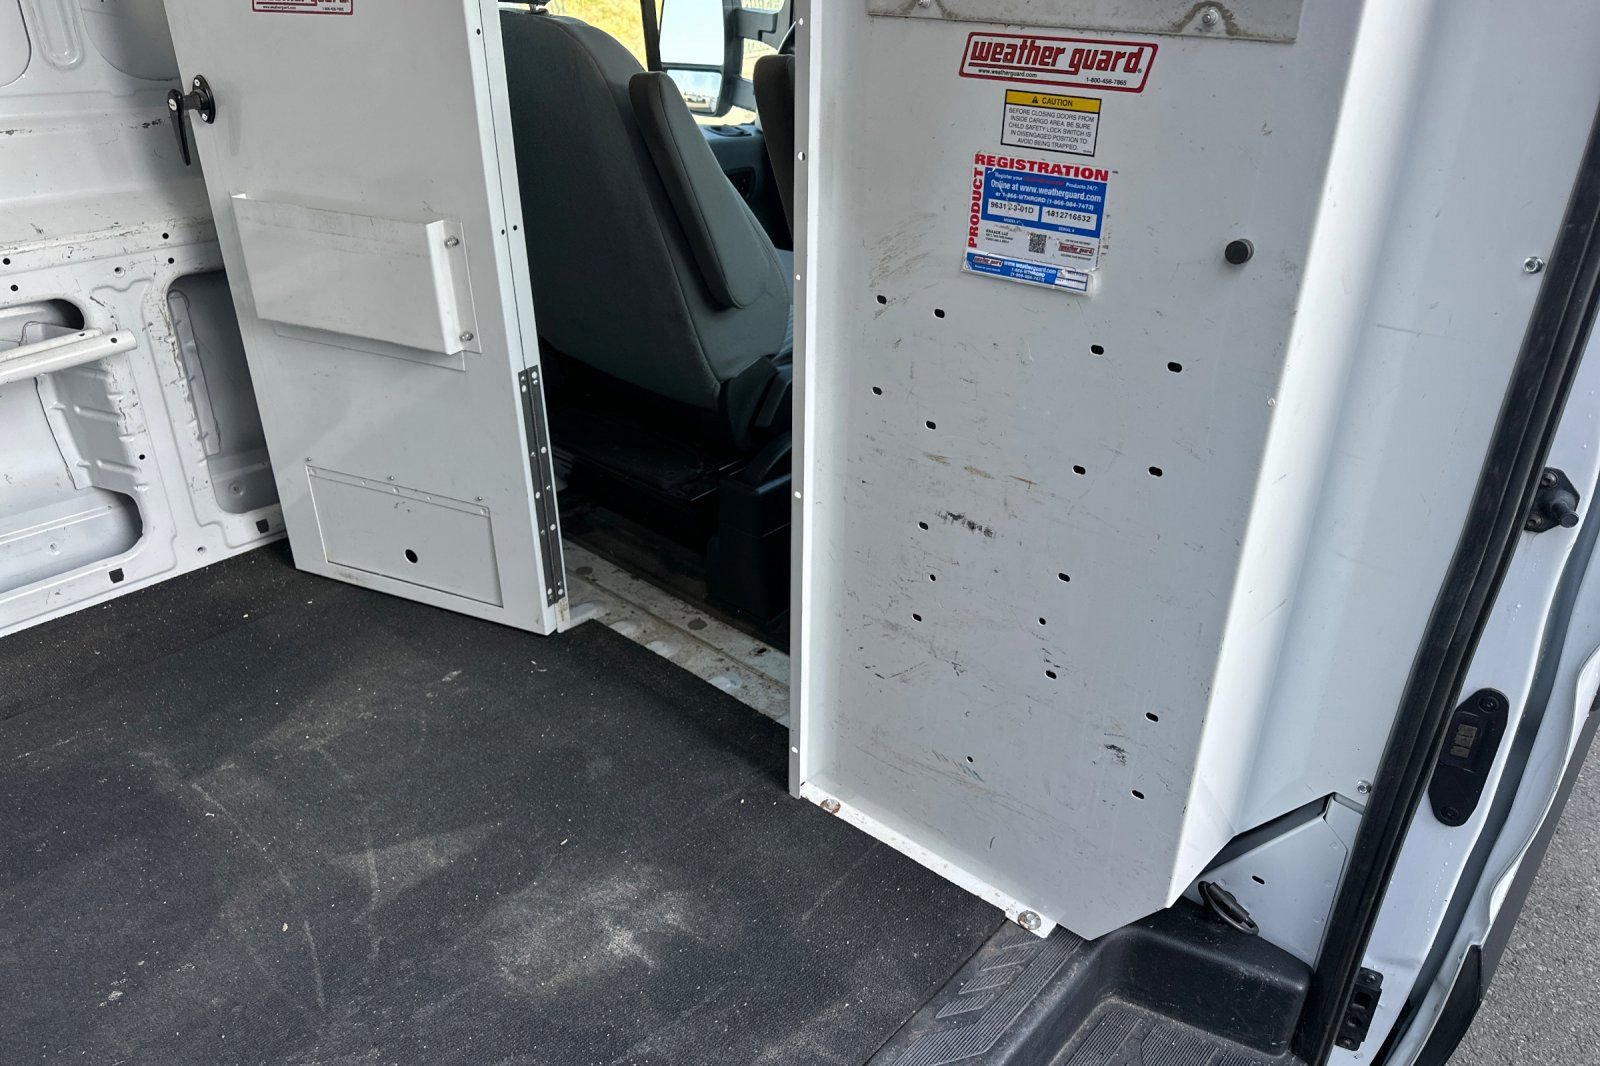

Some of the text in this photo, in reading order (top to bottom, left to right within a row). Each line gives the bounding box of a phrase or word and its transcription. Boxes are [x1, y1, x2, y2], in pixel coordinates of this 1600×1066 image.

[970, 39, 1066, 67] weather
[978, 68, 1037, 78] www.weatherguard.com
[1042, 98, 1073, 107] CAUTION
[1032, 110, 1055, 118] CLOSING
[1056, 112, 1076, 120] DOORS
[1017, 130, 1052, 140] DISENGAGED
[1052, 135, 1078, 143] POSITION
[1052, 142, 1078, 150] TRAPPED
[974, 153, 1109, 182] REGISTRATION
[991, 180, 1102, 203] Online at www.weatherguard.com
[968, 168, 984, 248] PRODUCT
